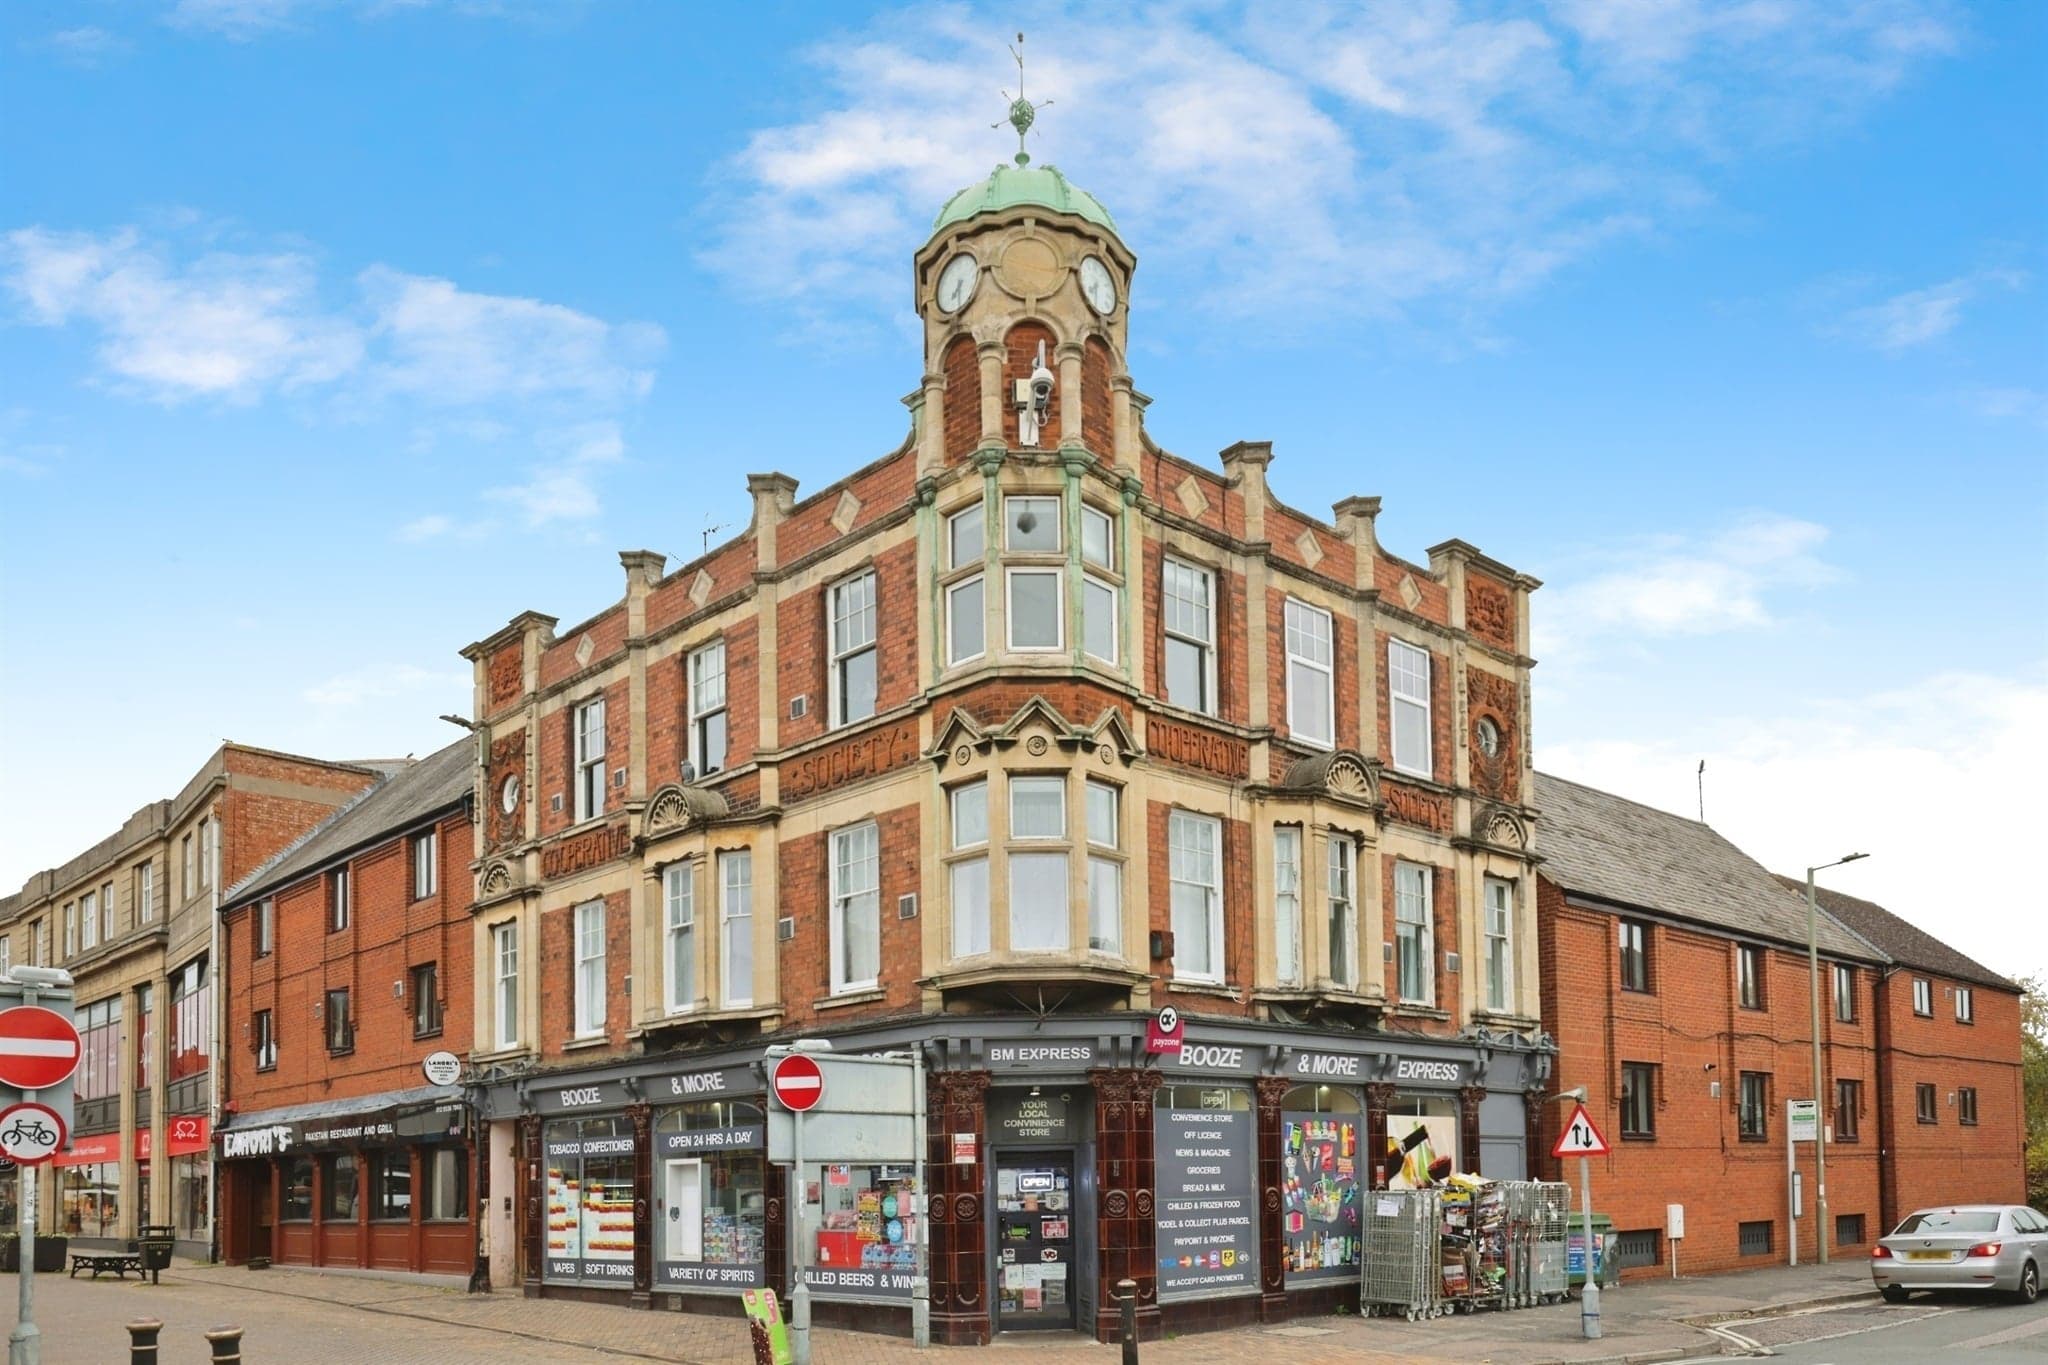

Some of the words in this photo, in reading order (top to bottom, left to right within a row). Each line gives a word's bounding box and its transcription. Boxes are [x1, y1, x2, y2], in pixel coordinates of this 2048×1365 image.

[1152, 1038, 1180, 1048] payzone
[991, 1048, 1015, 1060] BM
[1019, 1047, 1091, 1060] EXPRESS
[1179, 1046, 1243, 1069] BOOZE
[1297, 1054, 1309, 1073] &
[1312, 1055, 1359, 1076] MORE
[1397, 1060, 1459, 1081] EXPRESS
[671, 1077, 683, 1095] &
[683, 1072, 725, 1092] MORE
[560, 1086, 602, 1107] BOOZE
[1021, 1100, 1048, 1109] YOUR
[1019, 1110, 1050, 1118] LOCAL
[1171, 1113, 1213, 1122] CONVENIENCE
[1214, 1114, 1233, 1122] STORE
[1004, 1119, 1065, 1128] CONVINIENCE
[330, 1127, 363, 1140] RESTAURANT
[364, 1125, 376, 1136] AND
[377, 1124, 393, 1135] GRILL
[1019, 1128, 1050, 1137] STORE
[1184, 1131, 1197, 1139] OFF
[1198, 1131, 1222, 1140] LICENCE
[669, 1136, 692, 1148] OPEN
[693, 1134, 704, 1146] 24
[705, 1132, 724, 1146] HRS
[725, 1132, 733, 1144] A
[735, 1131, 752, 1144] DAY
[550, 1142, 580, 1155] TOBACCO
[1175, 1148, 1194, 1157] NEWS
[1200, 1148, 1231, 1157] MAGAZINE
[1187, 1166, 1221, 1175] GROCERIES
[1023, 1178, 1050, 1187] OPEN
[1182, 1184, 1205, 1192] BREAD
[1211, 1183, 1225, 1192] MILK
[1167, 1202, 1193, 1210] CHILLED
[1199, 1201, 1223, 1209] FROZEN
[1224, 1200, 1241, 1208] FOOD
[1157, 1220, 1177, 1229] YODEL
[1184, 1218, 1211, 1227] COLLECT
[1212, 1217, 1228, 1226] PLUS
[1228, 1216, 1250, 1225] PARCEL
[1209, 1234, 1236, 1244] PAYZONE
[553, 1262, 575, 1274] VAPES
[585, 1263, 605, 1275] SOFT
[606, 1264, 634, 1277] DRINKS
[668, 1267, 703, 1280] VARIETY
[706, 1268, 718, 1280] OF
[721, 1269, 755, 1282] SPIRITS
[839, 1272, 874, 1287] BEERS
[881, 1274, 889, 1288] &
[1166, 1279, 1176, 1287] WE
[1176, 1277, 1199, 1286] ACCEPT
[1199, 1276, 1215, 1284] CARD
[1216, 1273, 1244, 1282] PAYMENTS
